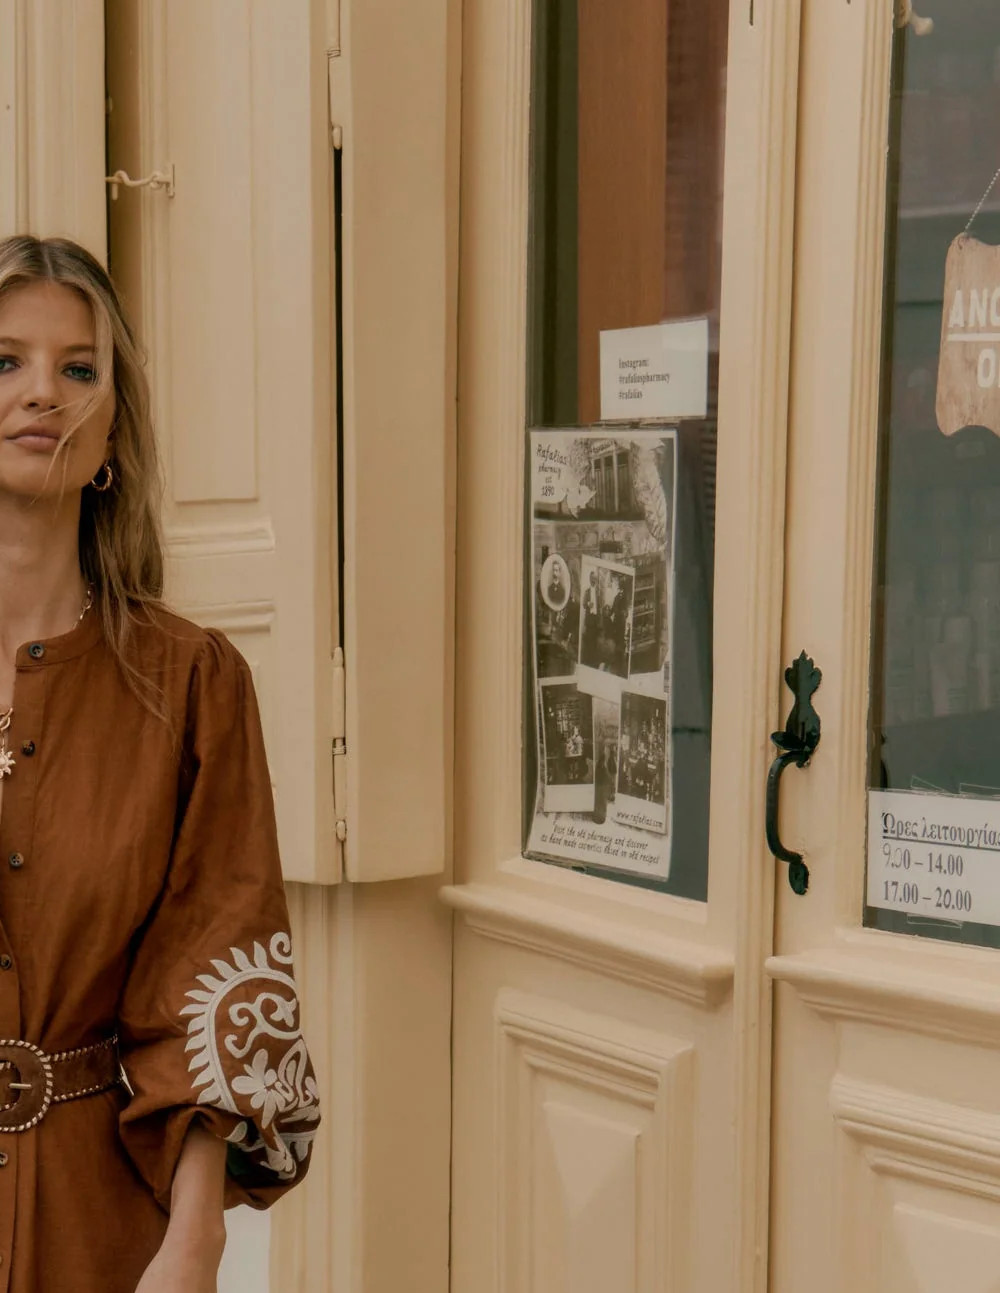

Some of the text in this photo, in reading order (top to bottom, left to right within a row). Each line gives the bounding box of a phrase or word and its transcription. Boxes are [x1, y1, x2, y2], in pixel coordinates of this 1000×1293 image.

[976, 348, 1000, 388] O
[537, 444, 567, 465] Rafalias
[882, 812, 918, 839] Ώρες
[928, 852, 964, 877] 14.00
[884, 880, 919, 905] 17.00
[935, 886, 972, 912] 20.00
